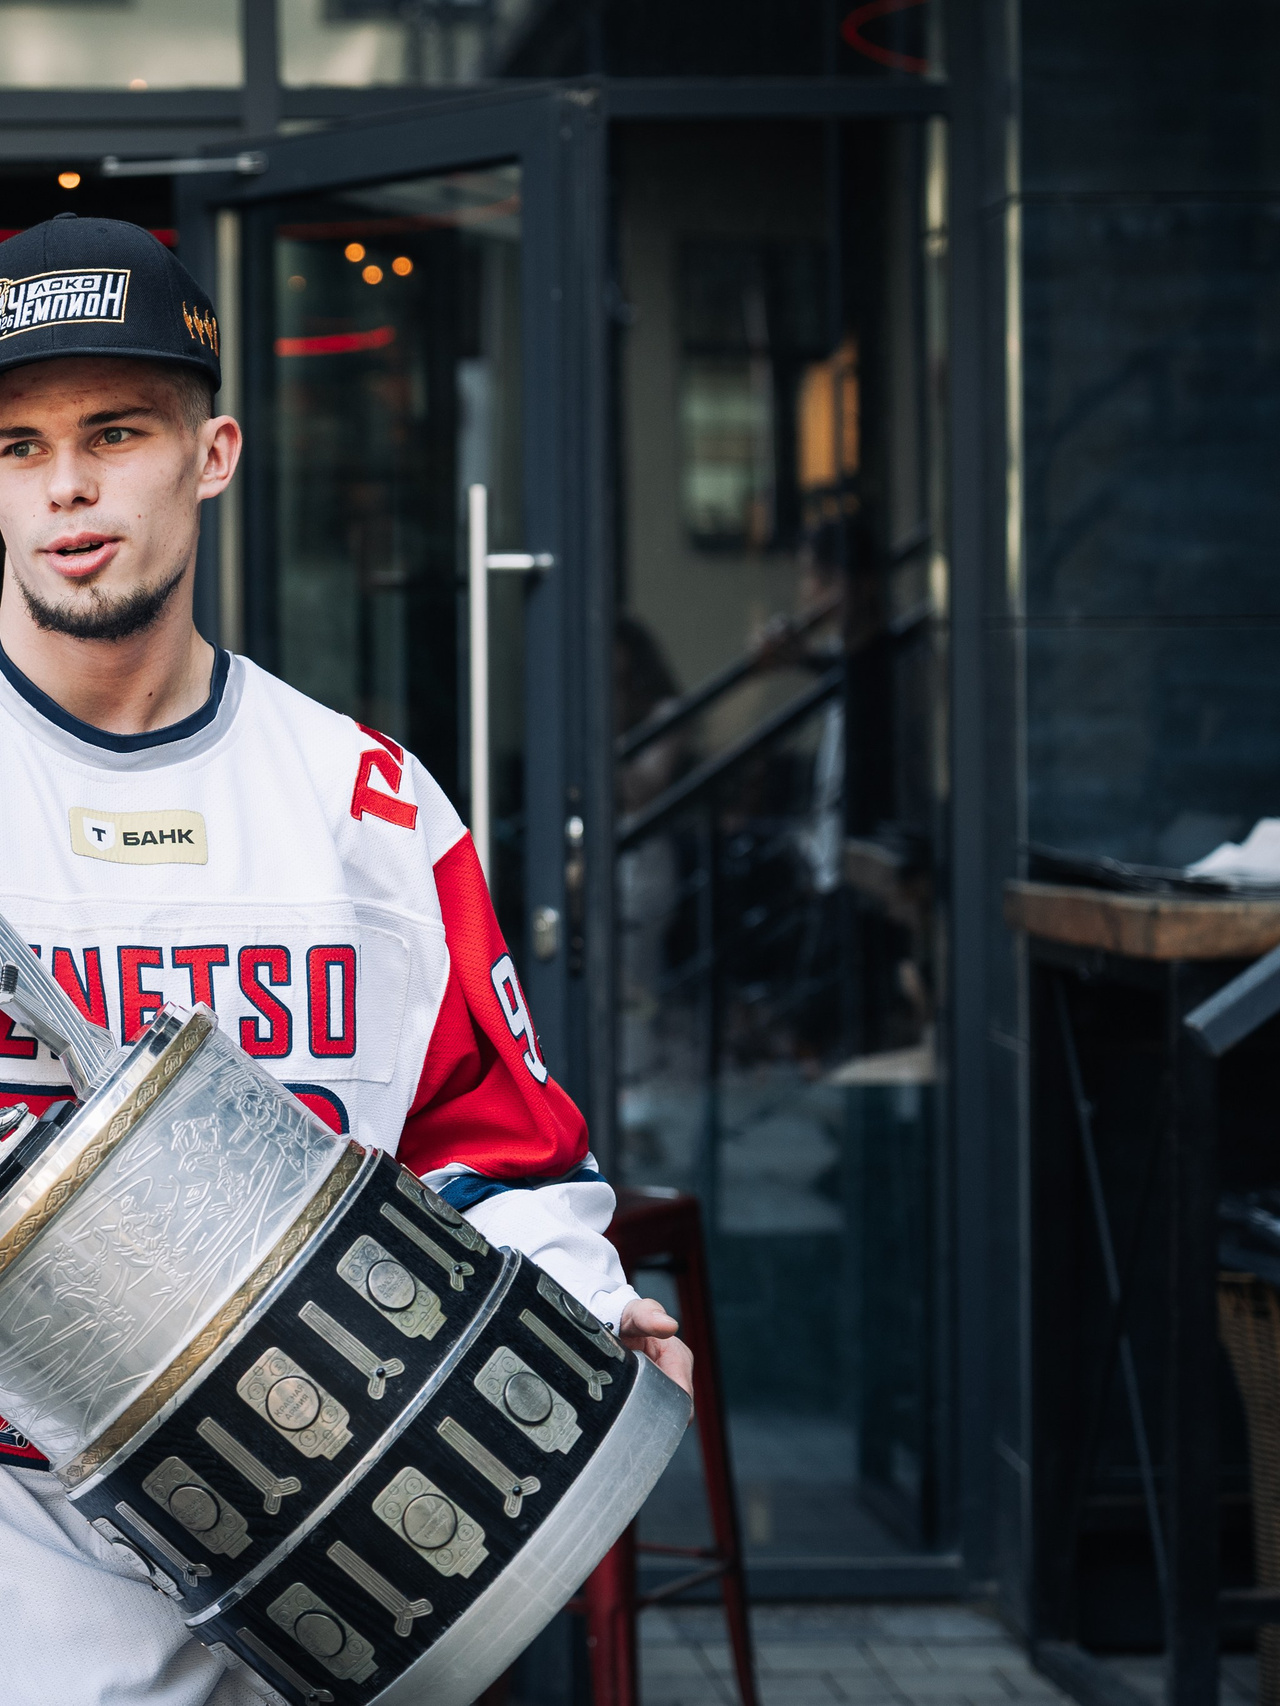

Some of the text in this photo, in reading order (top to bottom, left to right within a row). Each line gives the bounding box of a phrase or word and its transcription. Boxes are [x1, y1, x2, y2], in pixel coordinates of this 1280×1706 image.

[7, 274, 126, 329] ЧЕМПИОН
[122, 828, 195, 846] БАНК
[284, 1393, 309, 1421] АРМИЯ
